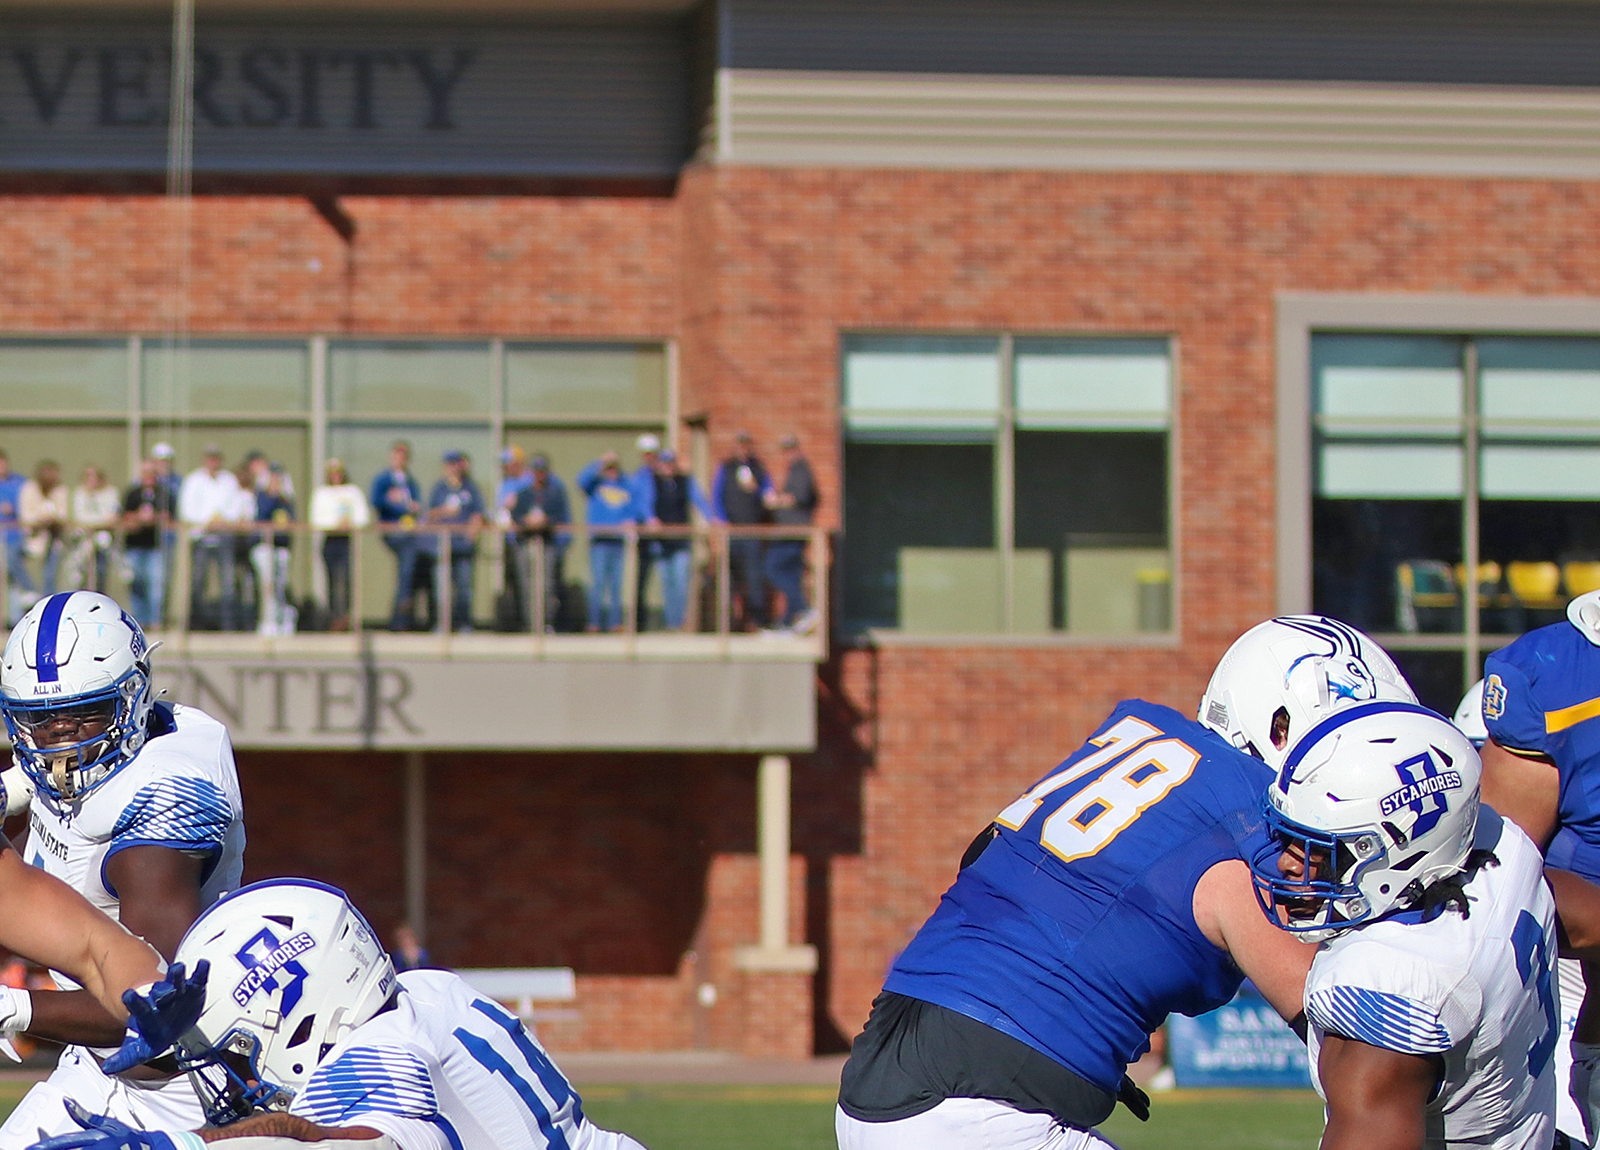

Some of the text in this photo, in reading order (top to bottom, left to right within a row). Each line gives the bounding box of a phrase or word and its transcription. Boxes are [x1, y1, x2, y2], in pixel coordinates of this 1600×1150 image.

[32, 683, 62, 696] ALL IN
[150, 664, 427, 736] NTER
[994, 715, 1203, 864] 78
[1380, 771, 1462, 816] SYCAMORES
[45, 832, 69, 861] STATE
[233, 932, 316, 1007] SYCAMORES
